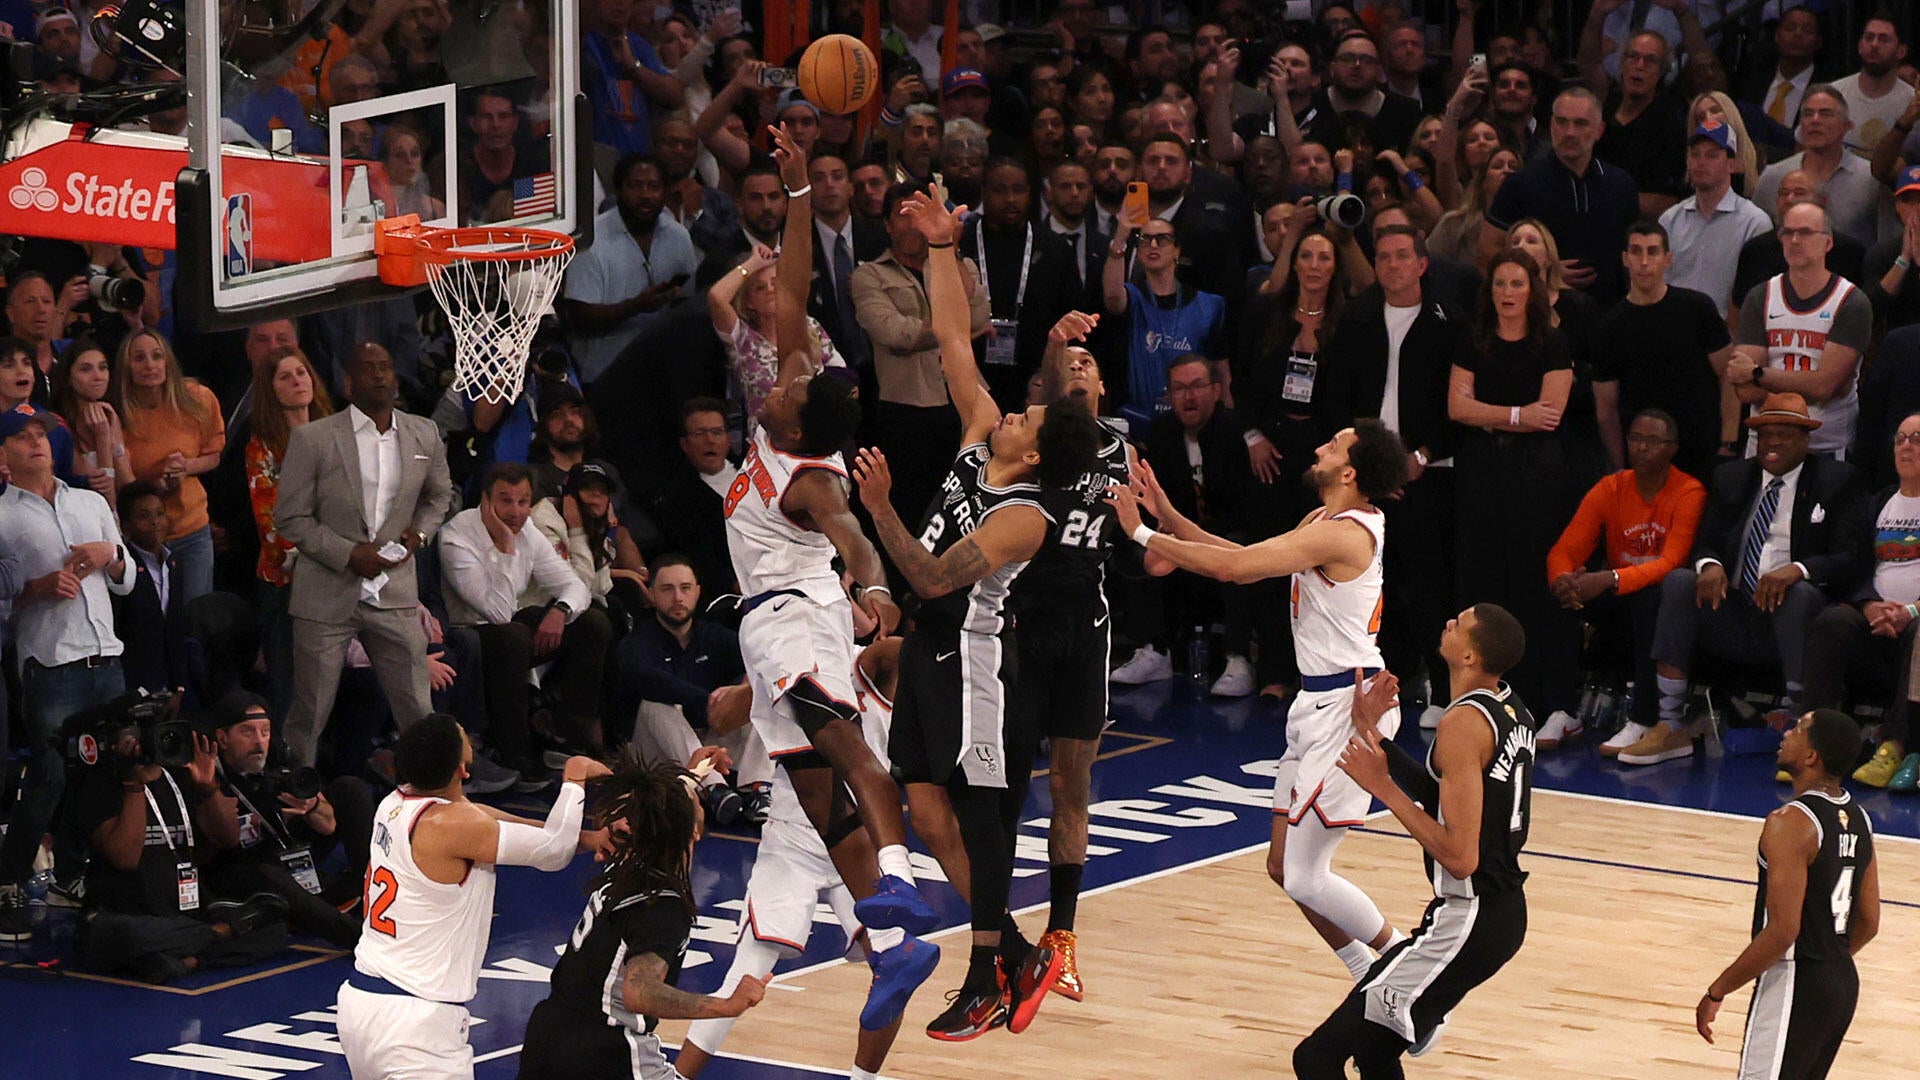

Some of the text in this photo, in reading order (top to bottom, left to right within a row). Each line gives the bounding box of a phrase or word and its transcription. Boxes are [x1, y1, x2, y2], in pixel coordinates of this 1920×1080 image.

[723, 472, 751, 520] 8
[920, 513, 945, 553] 2
[1060, 509, 1108, 549] 24
[1509, 762, 1524, 833] 1
[1838, 833, 1858, 858] FOX
[1830, 866, 1856, 935] 4
